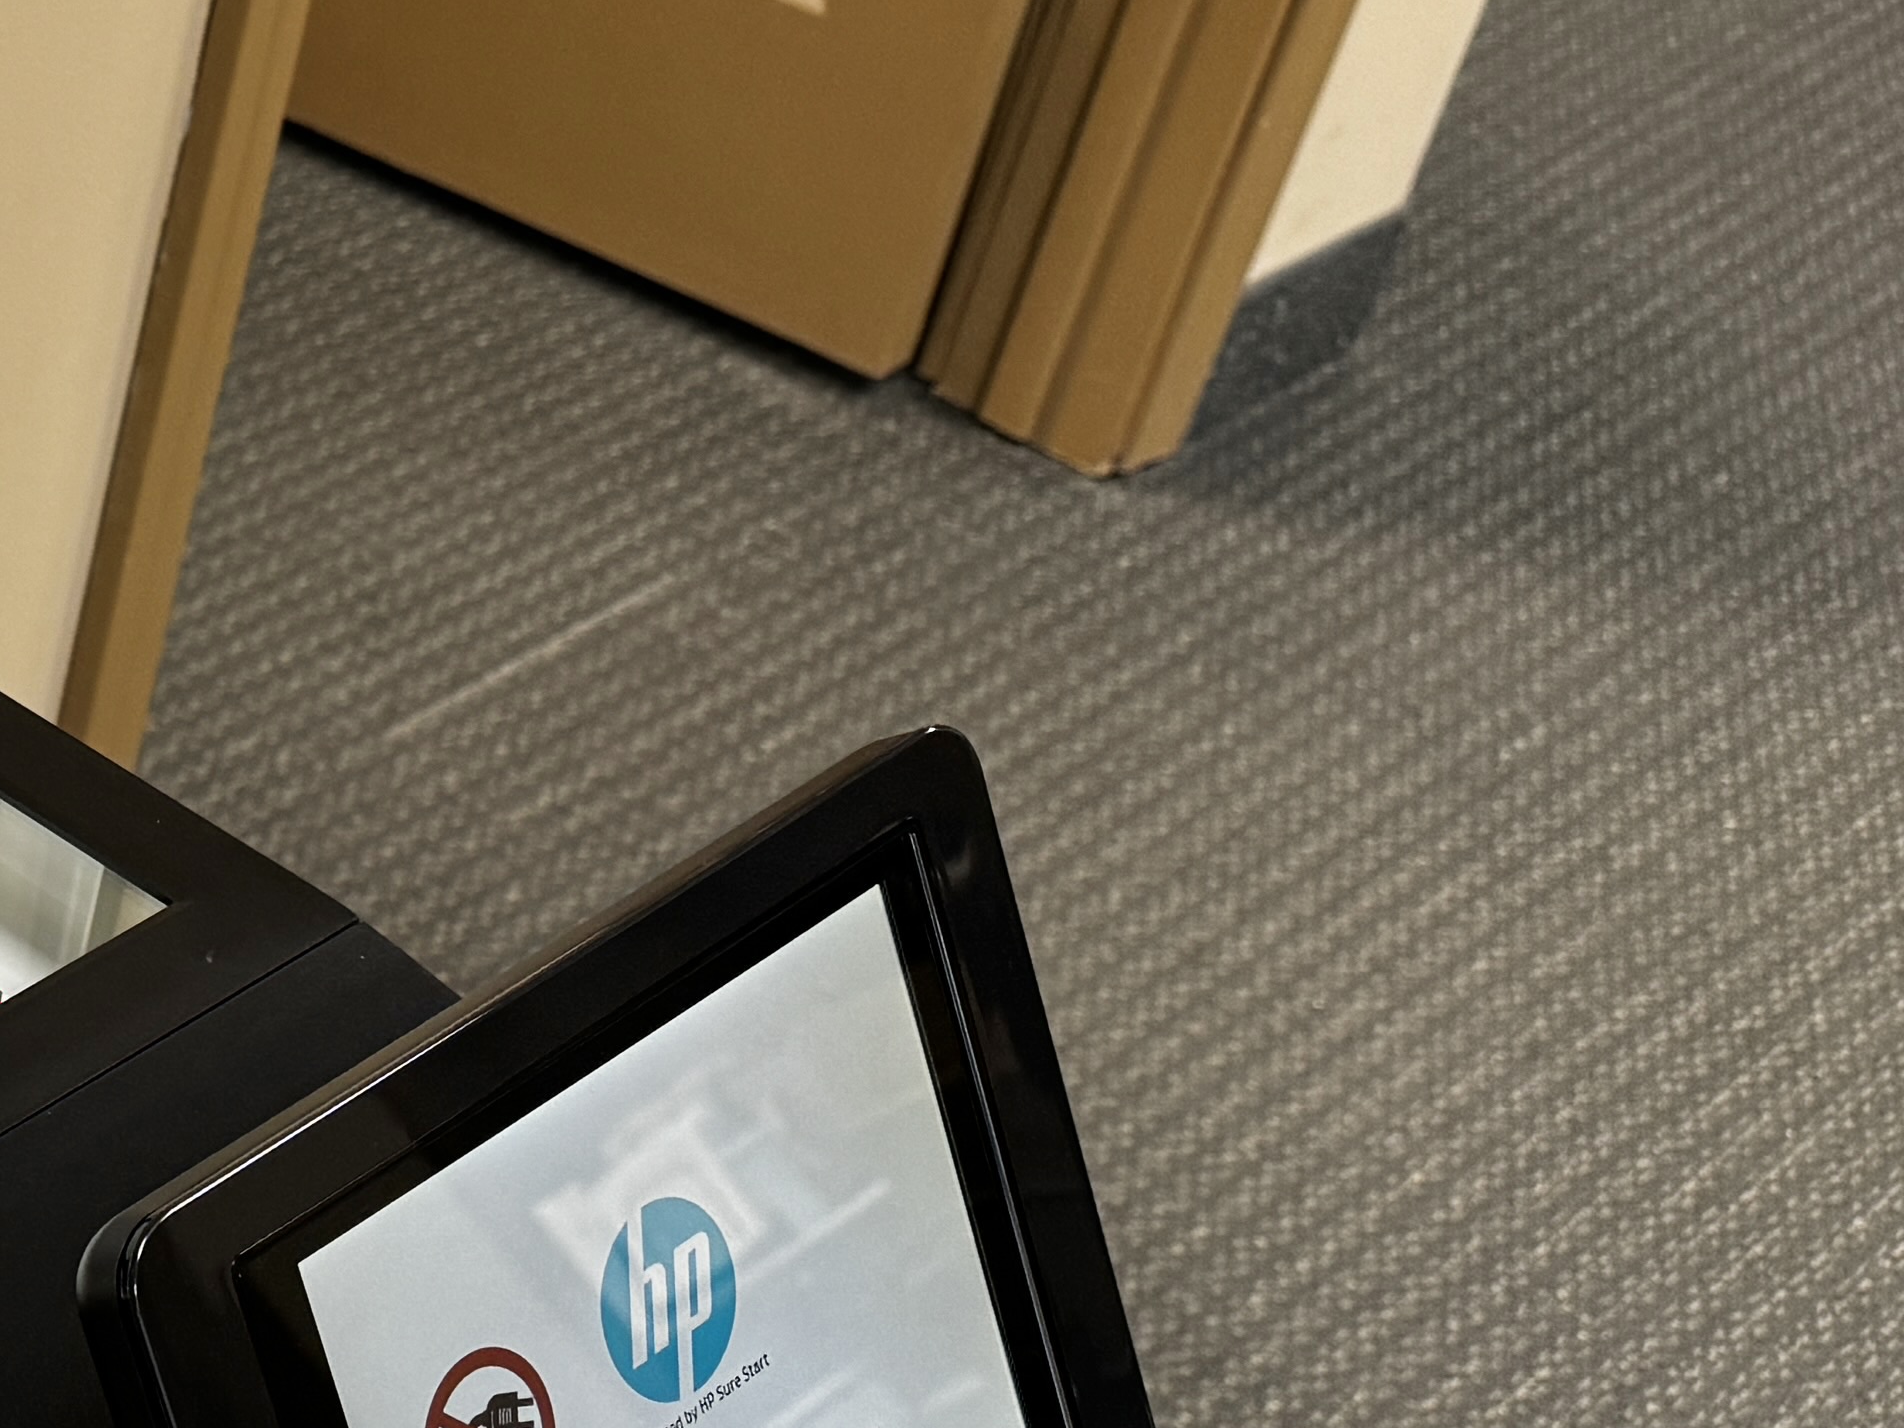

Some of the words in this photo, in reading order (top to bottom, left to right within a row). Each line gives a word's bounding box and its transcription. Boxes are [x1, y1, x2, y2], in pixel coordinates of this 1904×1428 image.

[625, 1202, 714, 1402] hp
[684, 1406, 698, 1424] by
[698, 1392, 715, 1414] HP
[716, 1375, 742, 1401] Sure
[741, 1353, 770, 1383] Start
